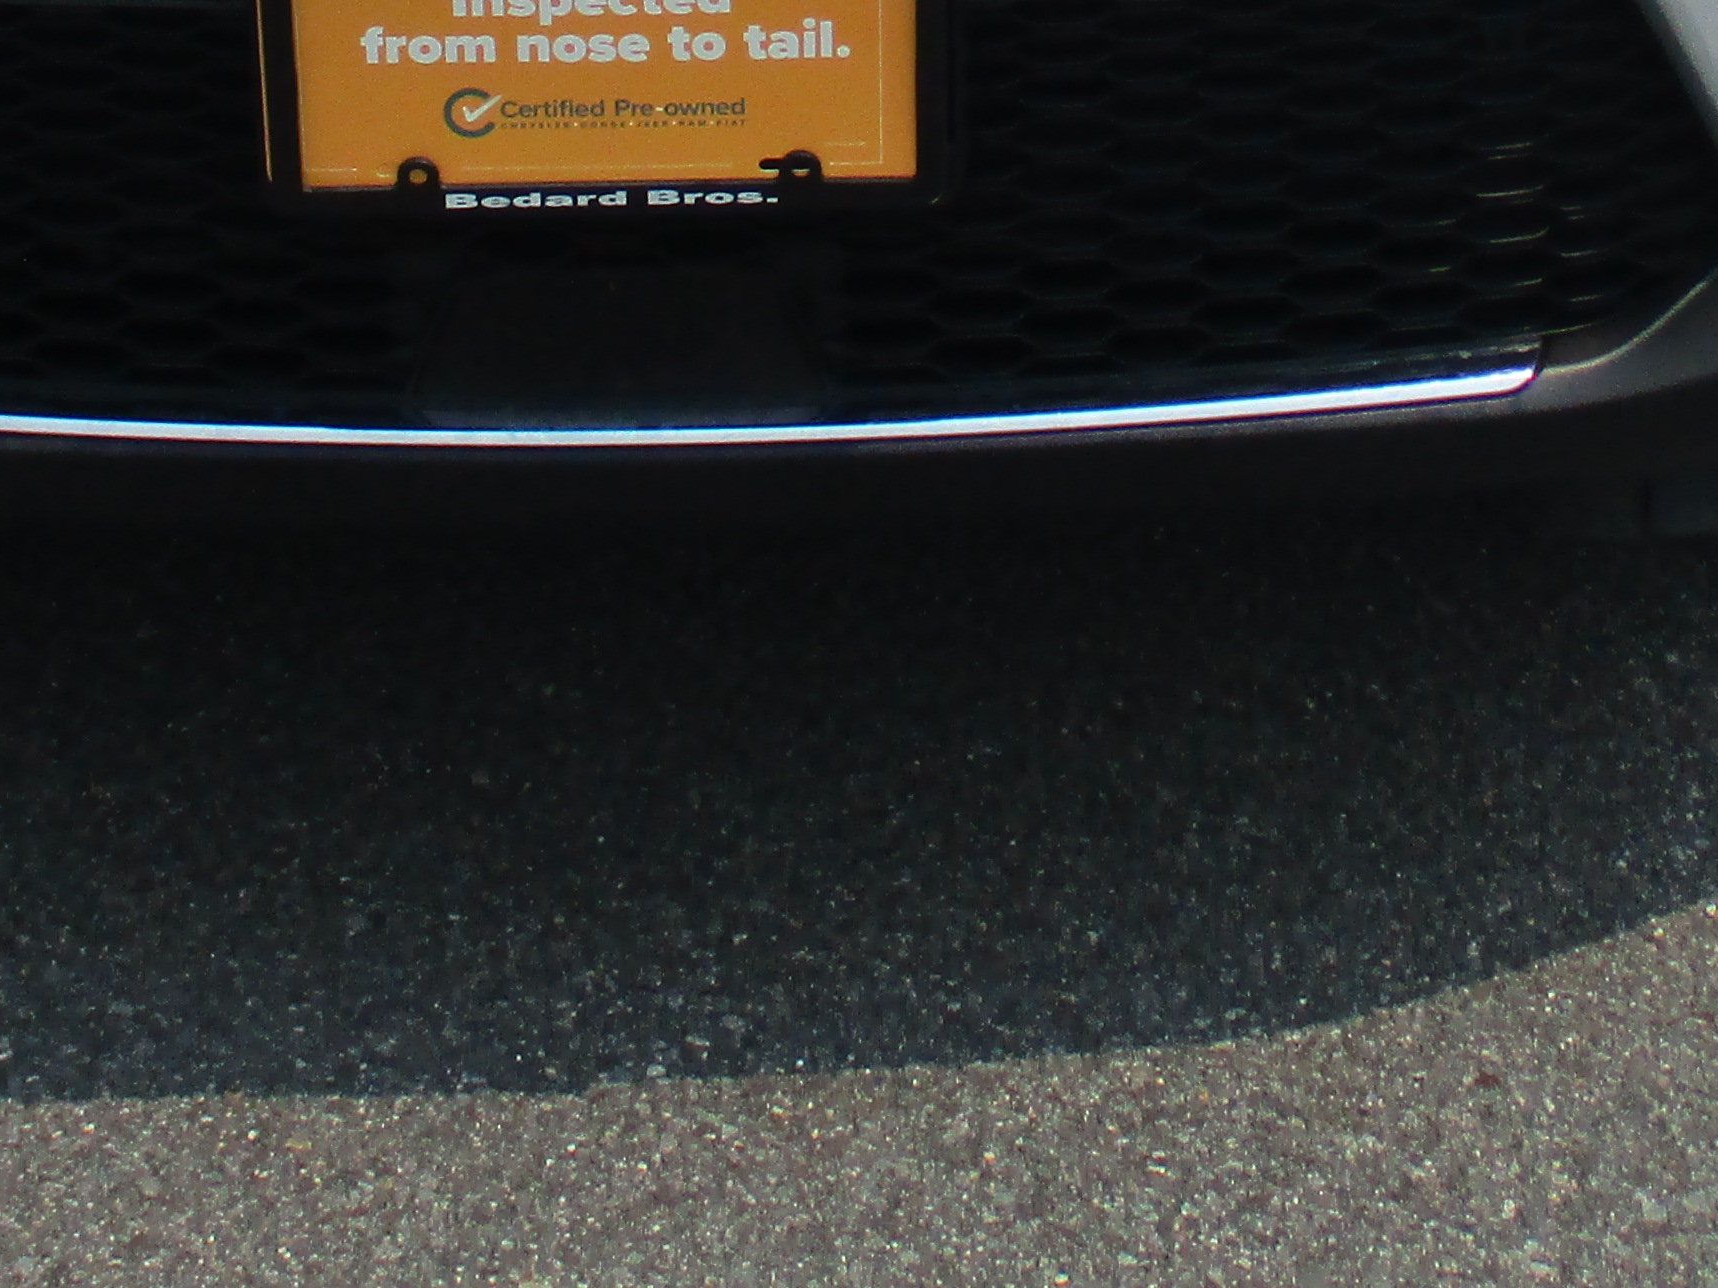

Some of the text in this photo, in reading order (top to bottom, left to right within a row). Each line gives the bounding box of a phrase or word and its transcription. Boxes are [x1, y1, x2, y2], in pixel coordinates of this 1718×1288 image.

[360, 17, 851, 64] from nose to tail.
[500, 96, 746, 119] Certified Pre-owned
[445, 188, 779, 209] Bedard Bros.
